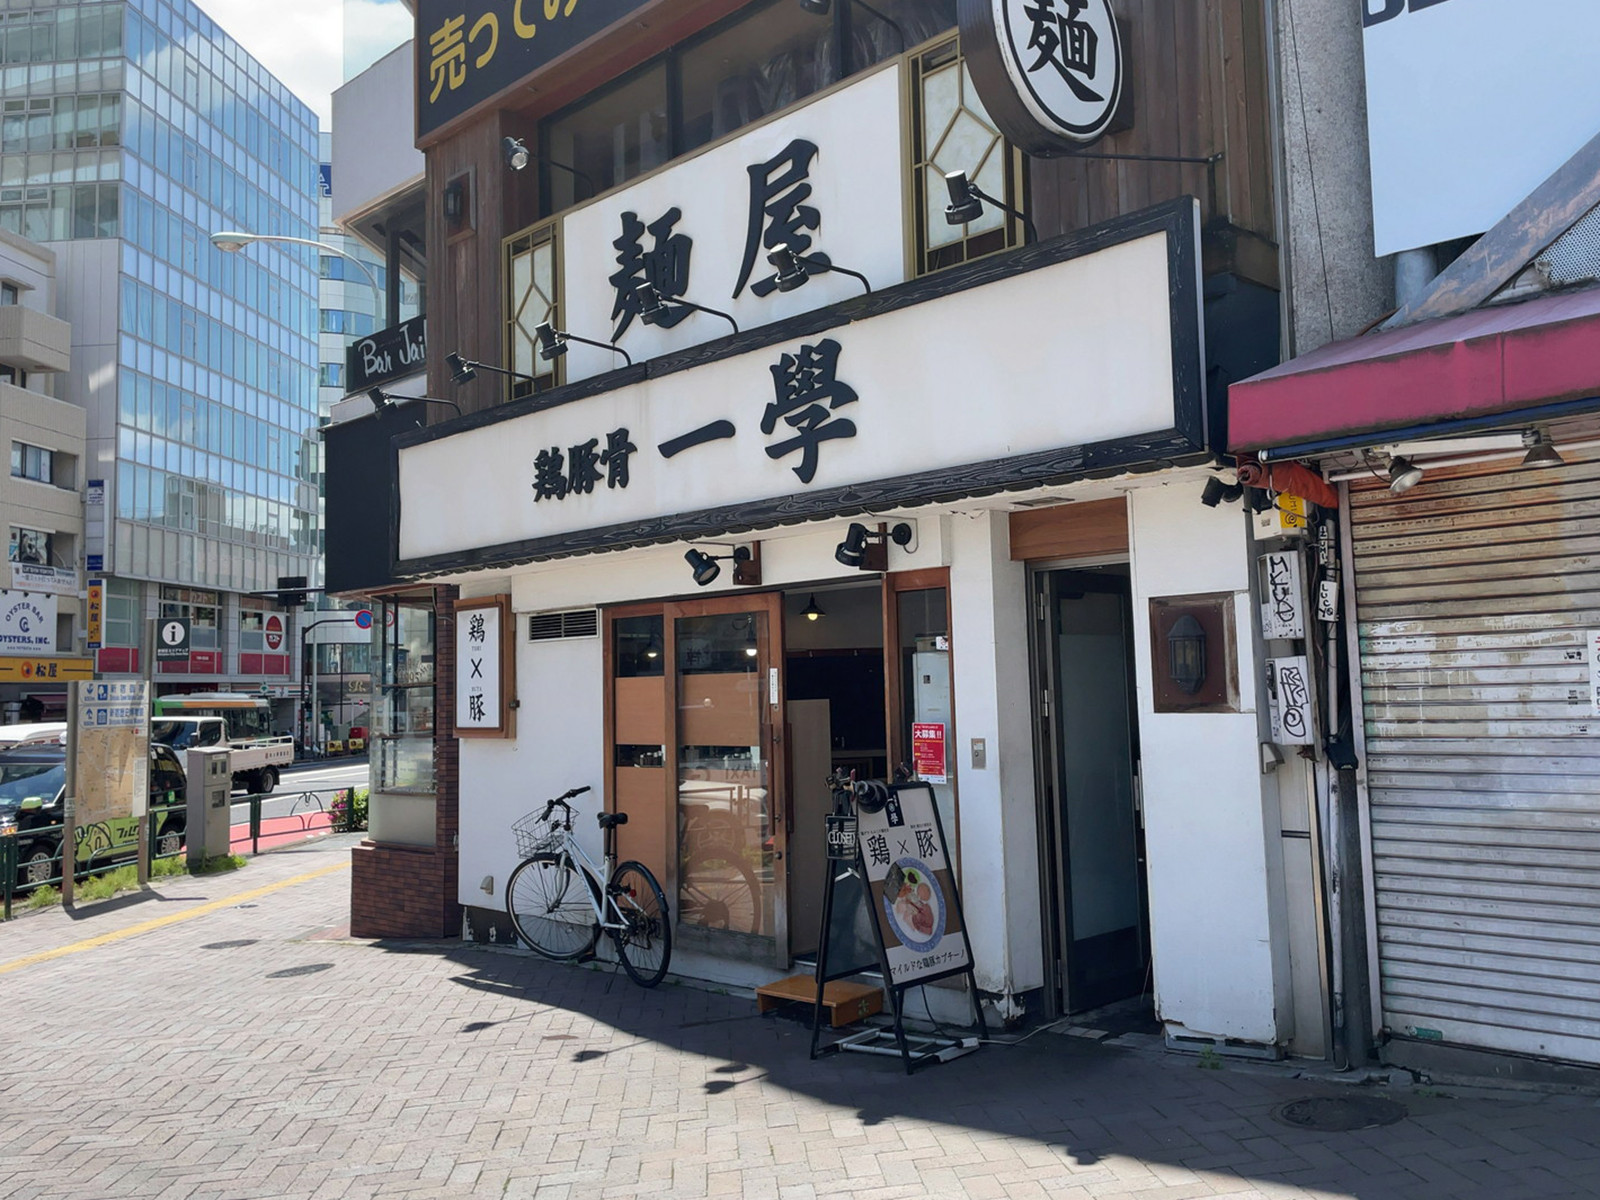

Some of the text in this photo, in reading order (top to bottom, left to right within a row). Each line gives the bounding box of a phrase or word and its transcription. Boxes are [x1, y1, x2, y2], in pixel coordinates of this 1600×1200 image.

[533, 428, 637, 502] 鶏豚骨
[5, 602, 44, 624] OYSTER BAR
[468, 613, 486, 643] 鶏
[35, 662, 58, 678] 松屋
[469, 694, 486, 722] 豚
[828, 831, 856, 846] CLOSED
[915, 828, 939, 859] 豚
